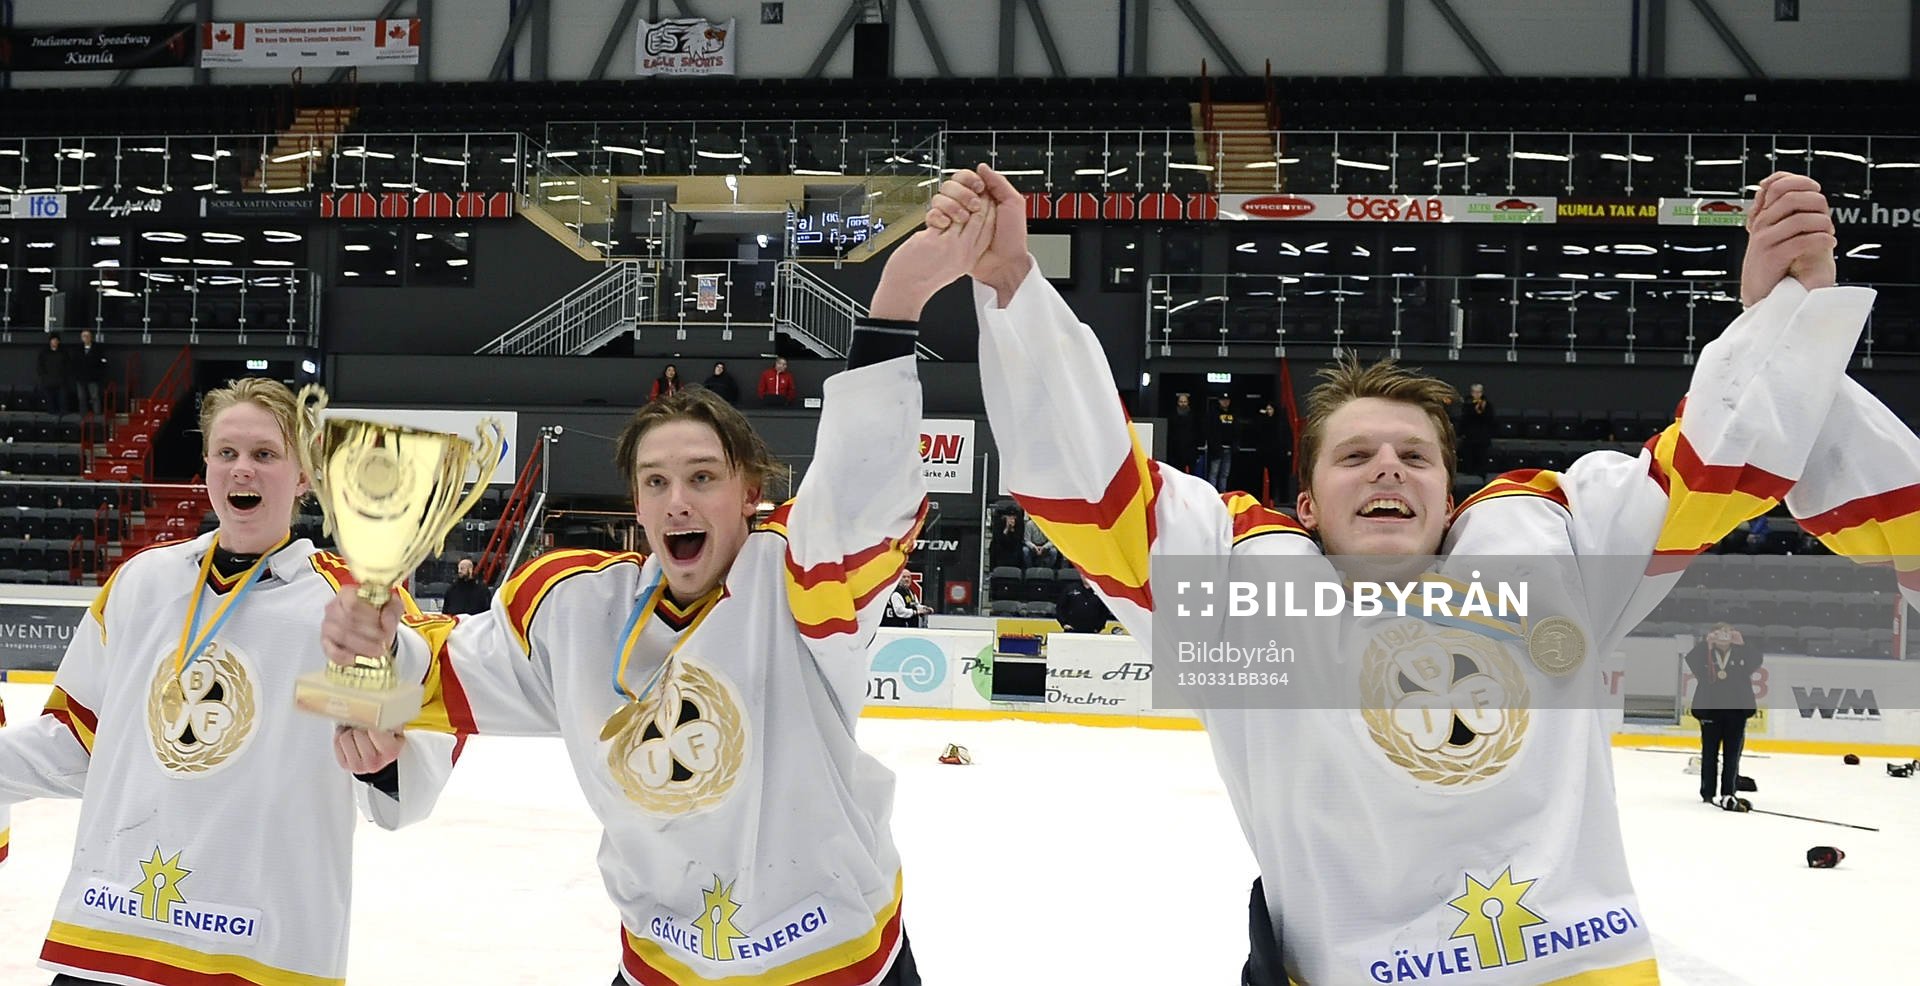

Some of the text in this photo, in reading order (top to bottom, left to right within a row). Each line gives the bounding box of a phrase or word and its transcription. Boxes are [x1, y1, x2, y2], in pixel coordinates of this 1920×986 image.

[31, 33, 152, 49] Indianerna Speedway
[64, 49, 114, 64] Kumla
[643, 55, 724, 69] EAGLE SPORTS
[30, 196, 59, 217] Ifö
[1347, 196, 1444, 221] ÖGS AB
[1558, 204, 1657, 217] KUMLA TAK AB
[0, 624, 78, 640] VENTU
[1377, 620, 1428, 650] 1912
[1046, 685, 1126, 706] Örebro
[1791, 686, 1881, 719] WM
[84, 886, 254, 936] GÄVLE ENERGI
[651, 906, 827, 959] GÄVLE ENERGI
[1370, 907, 1639, 984] GÄVLE ENERGI
